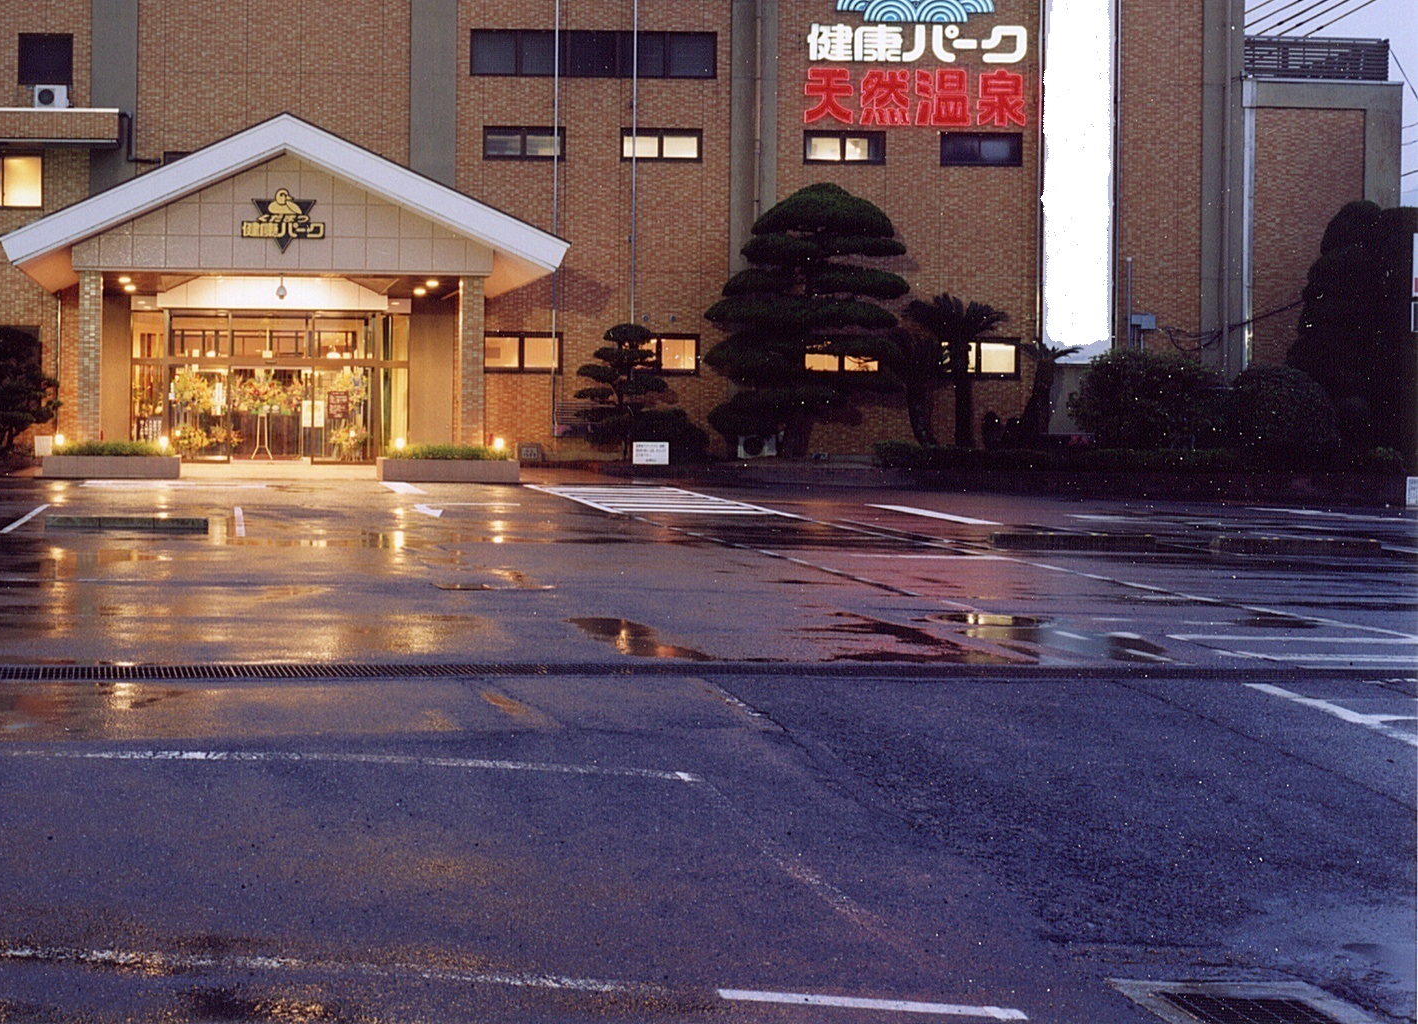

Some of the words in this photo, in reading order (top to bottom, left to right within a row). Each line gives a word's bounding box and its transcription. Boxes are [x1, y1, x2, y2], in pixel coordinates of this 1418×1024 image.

[807, 23, 1027, 63] 健康パーク
[804, 67, 1026, 126] 天然温泉
[242, 221, 325, 238] 健康パーク
